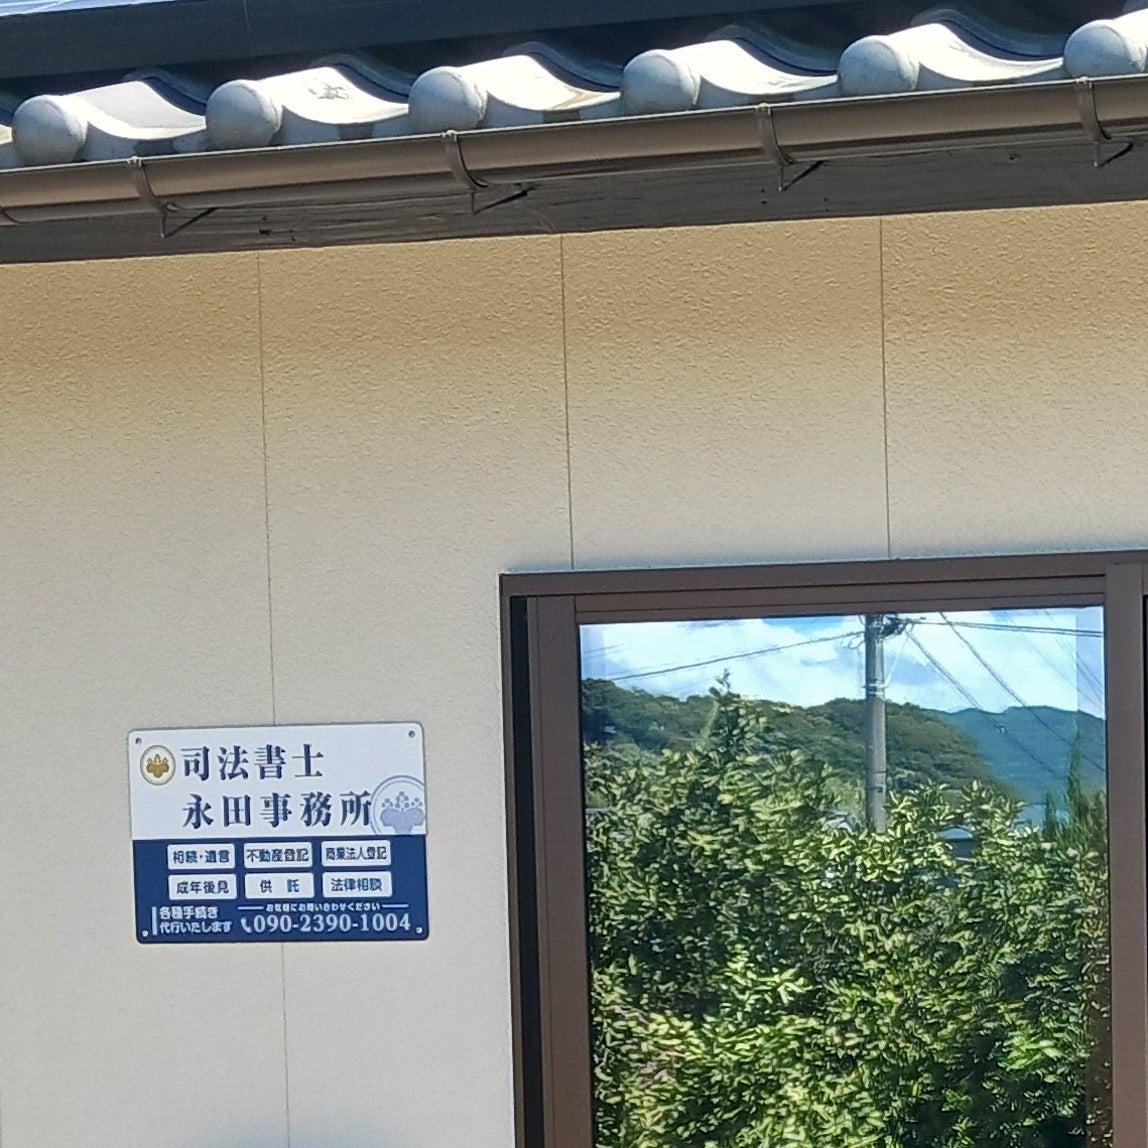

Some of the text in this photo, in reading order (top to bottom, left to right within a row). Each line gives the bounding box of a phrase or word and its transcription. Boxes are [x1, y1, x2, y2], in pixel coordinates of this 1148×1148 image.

[180, 743, 325, 782] 司法書士
[181, 790, 372, 829] 永田事務所
[246, 848, 310, 863] 不動産登記
[325, 846, 388, 861] 商業法人登記
[176, 880, 230, 895] 成年後見
[330, 877, 383, 893] 法律相談
[159, 905, 219, 920] 各種手続き
[159, 920, 233, 935] 代行いたします
[253, 912, 412, 934] 090-2390-1004
